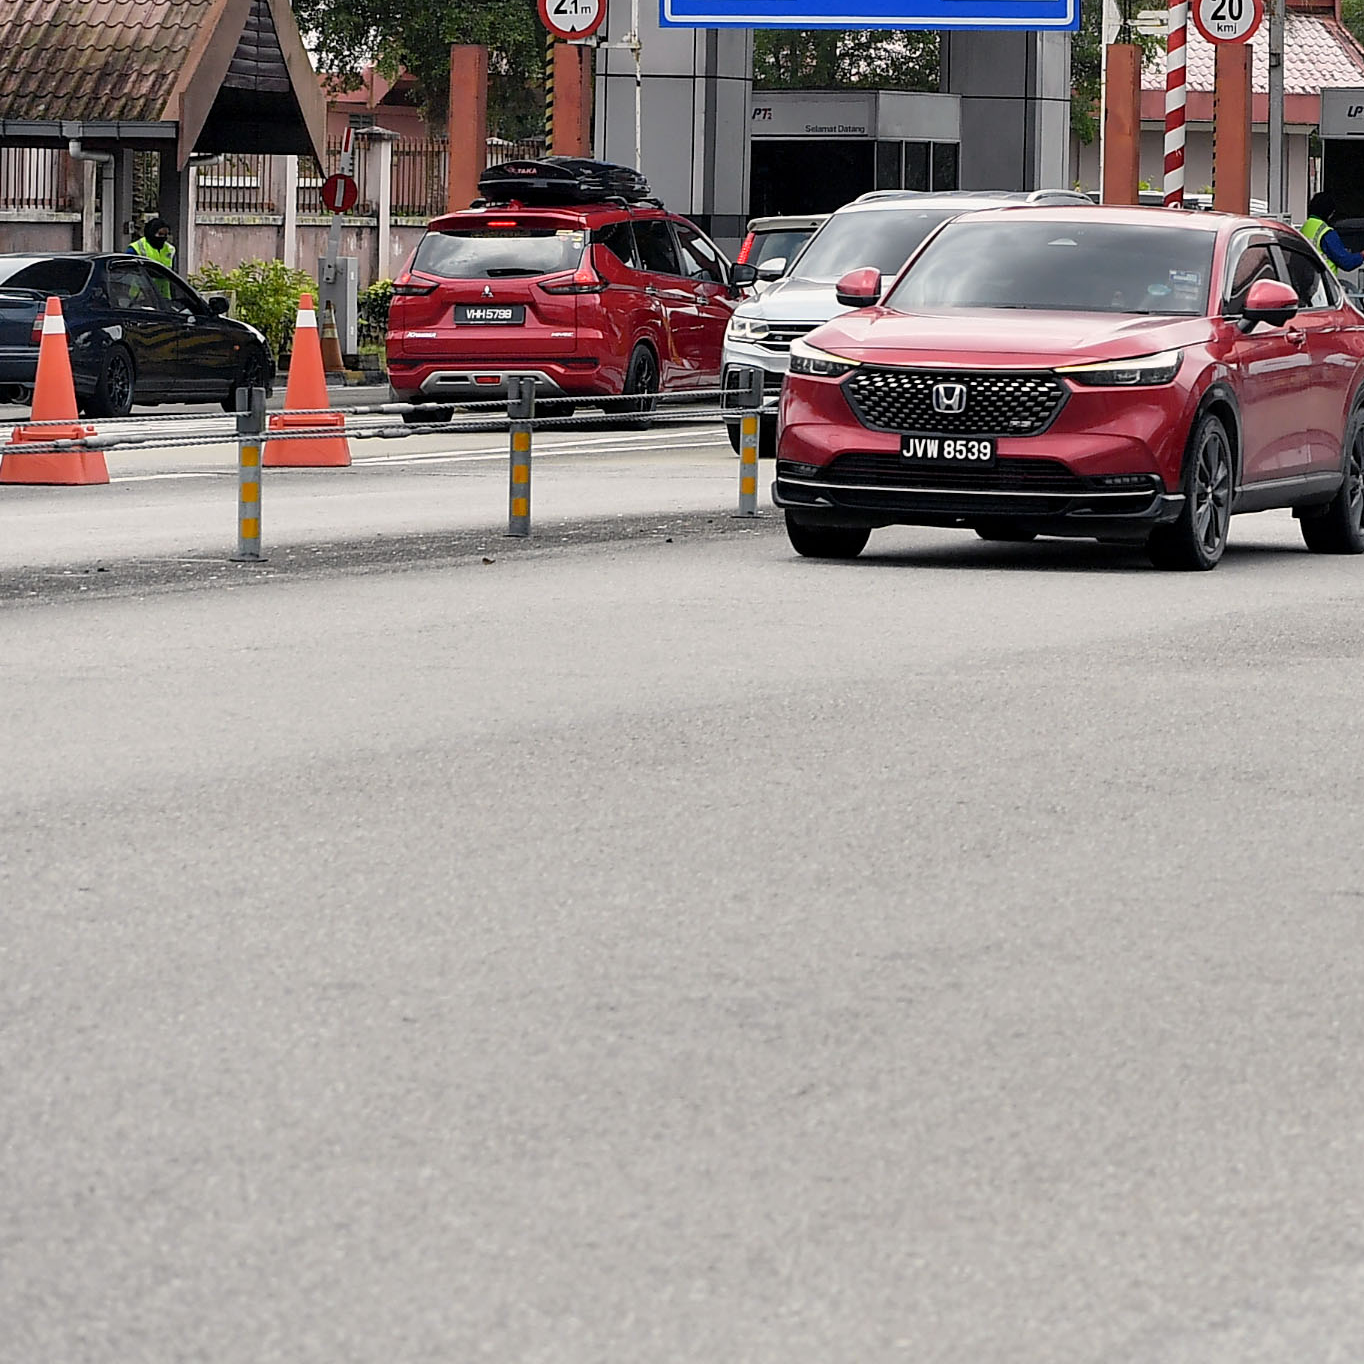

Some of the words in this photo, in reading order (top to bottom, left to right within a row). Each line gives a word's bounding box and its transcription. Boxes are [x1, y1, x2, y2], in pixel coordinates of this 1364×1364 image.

[805, 124, 837, 133] Selamat
[838, 124, 866, 134] Datang
[902, 439, 939, 458] JVW
[943, 440, 991, 460] 8539
